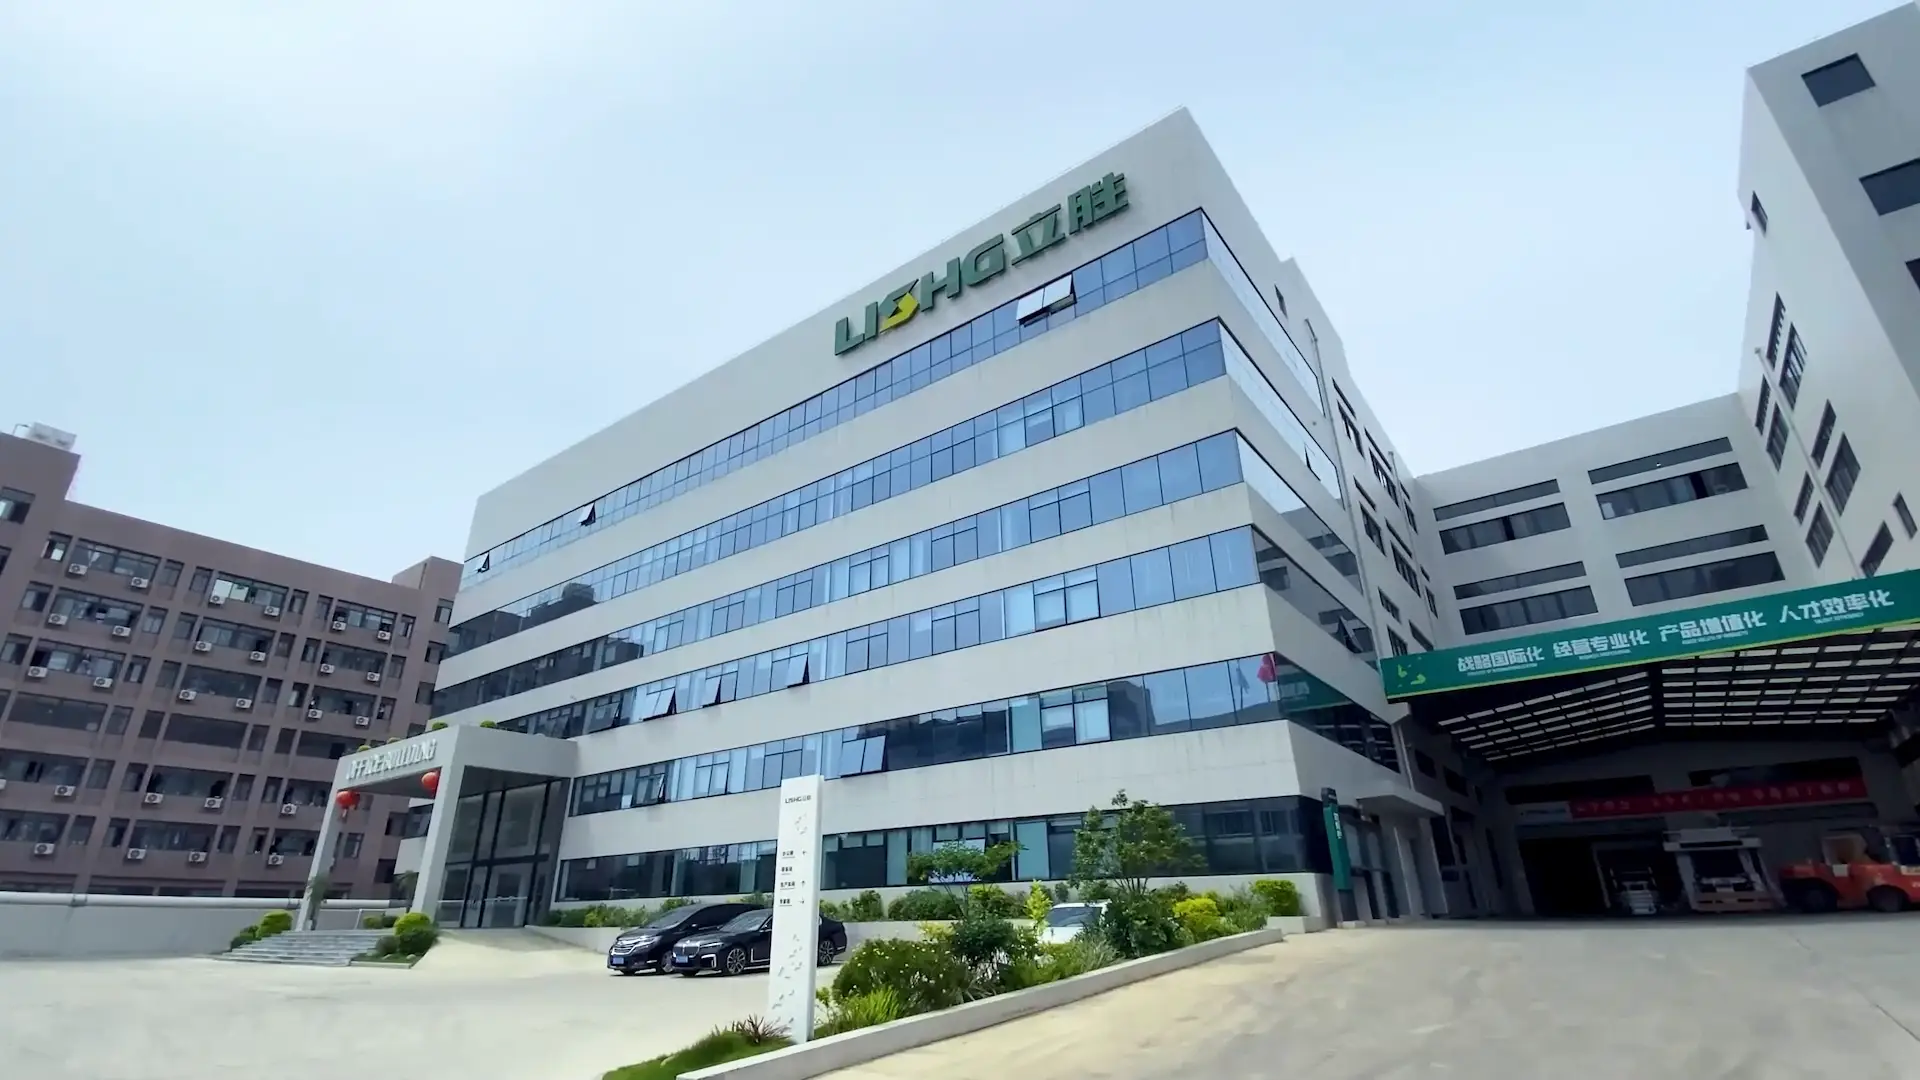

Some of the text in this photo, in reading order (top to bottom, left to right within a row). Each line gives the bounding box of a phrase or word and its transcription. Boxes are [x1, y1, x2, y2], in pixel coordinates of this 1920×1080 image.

[1011, 171, 1129, 267] 立胜
[1457, 646, 1546, 673] 战略国际化
[1552, 629, 1650, 659] 经营专业化
[1658, 610, 1768, 643] 产品增值化
[1779, 589, 1895, 624] 人才效率化
